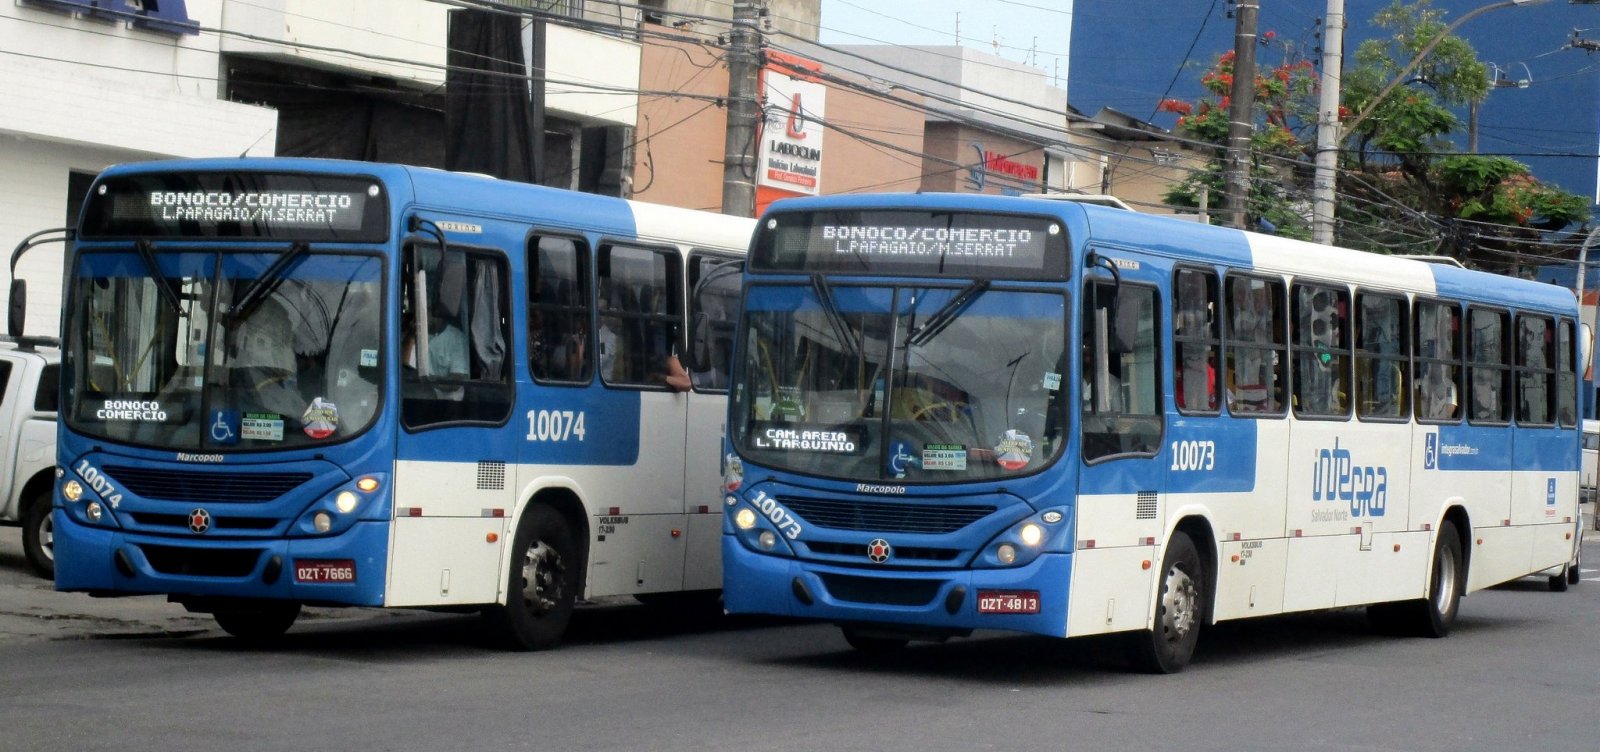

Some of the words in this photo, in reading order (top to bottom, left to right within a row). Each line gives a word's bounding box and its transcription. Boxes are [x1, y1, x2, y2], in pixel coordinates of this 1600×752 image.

[771, 139, 821, 162] LABOCLIN
[150, 191, 352, 209] BONOCO/COMERCIO
[163, 207, 337, 223] L.PAPAGAIO/M.SERRAT
[823, 225, 1032, 243] BONOCO/COMERCIO
[836, 240, 1017, 256] L.PAPAGAIO/M.SERRAT
[104, 400, 160, 411] BONOCO
[96, 409, 168, 421] COMERCIO
[526, 409, 586, 442] 10074
[766, 428, 800, 441] CAM.
[801, 430, 847, 443] AREIA
[756, 437, 771, 448] L.
[772, 438, 855, 453] TARQUINIO
[176, 452, 224, 463] Marcopolo
[1171, 440, 1215, 470] 10073
[76, 459, 123, 509] 10074
[856, 483, 906, 494] Marcopolo
[752, 490, 802, 540] 10073
